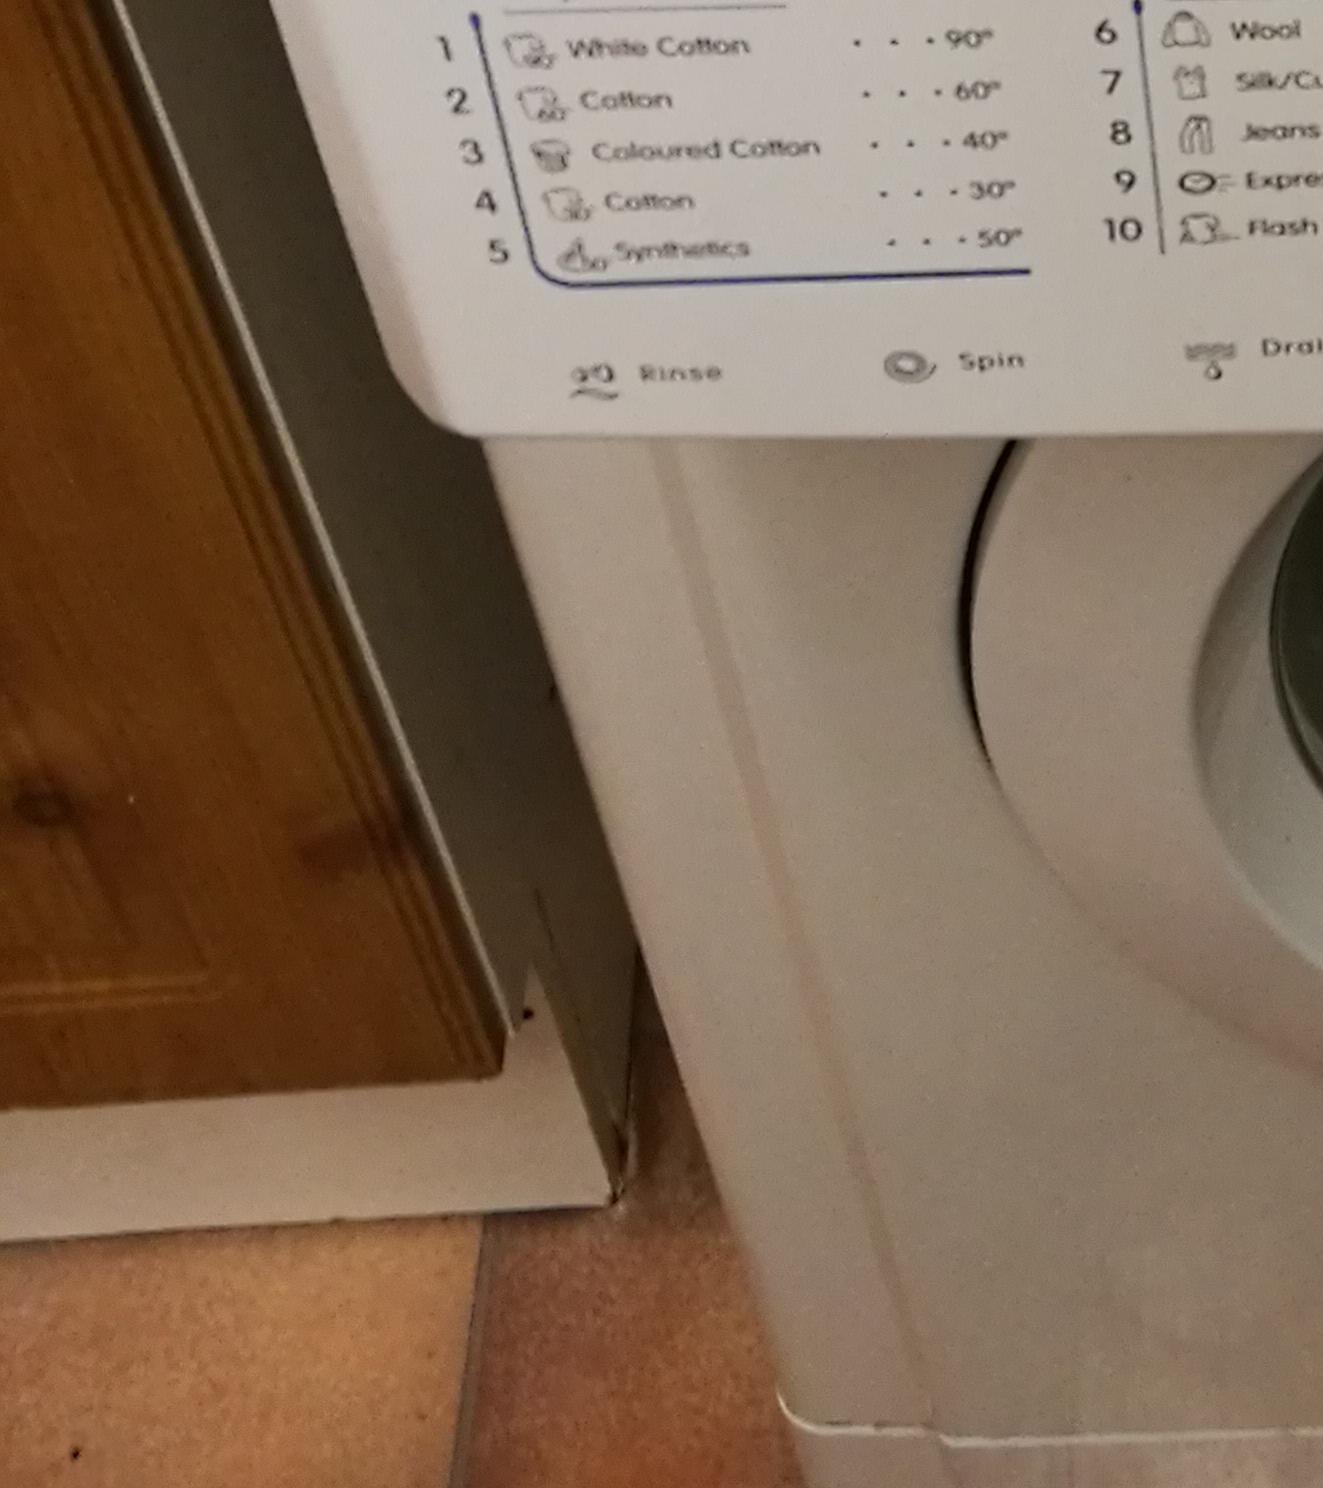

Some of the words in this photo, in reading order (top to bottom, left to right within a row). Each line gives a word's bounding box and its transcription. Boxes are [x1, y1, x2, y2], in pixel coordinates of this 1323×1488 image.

[1094, 19, 1119, 47] 6
[1230, 19, 1302, 43] Wool
[436, 36, 453, 62] 1
[566, 36, 650, 60] White
[656, 34, 752, 59] Cotton
[1099, 69, 1125, 96] 7
[446, 88, 469, 115] 2
[579, 89, 674, 111] Cotton
[1109, 119, 1133, 147] 8
[1240, 120, 1321, 142] Jeans
[459, 140, 484, 165] 3
[591, 138, 723, 162] Coloured
[728, 136, 822, 158] Cotton
[1113, 169, 1137, 196] 9
[474, 190, 498, 213] 4
[604, 190, 696, 212] Cotton
[1103, 218, 1144, 244] 10
[1247, 220, 1320, 238] Flash
[488, 240, 510, 265] 5
[614, 237, 752, 265] Synthetics
[638, 362, 724, 384] Rinse
[958, 352, 1026, 375] Spin
